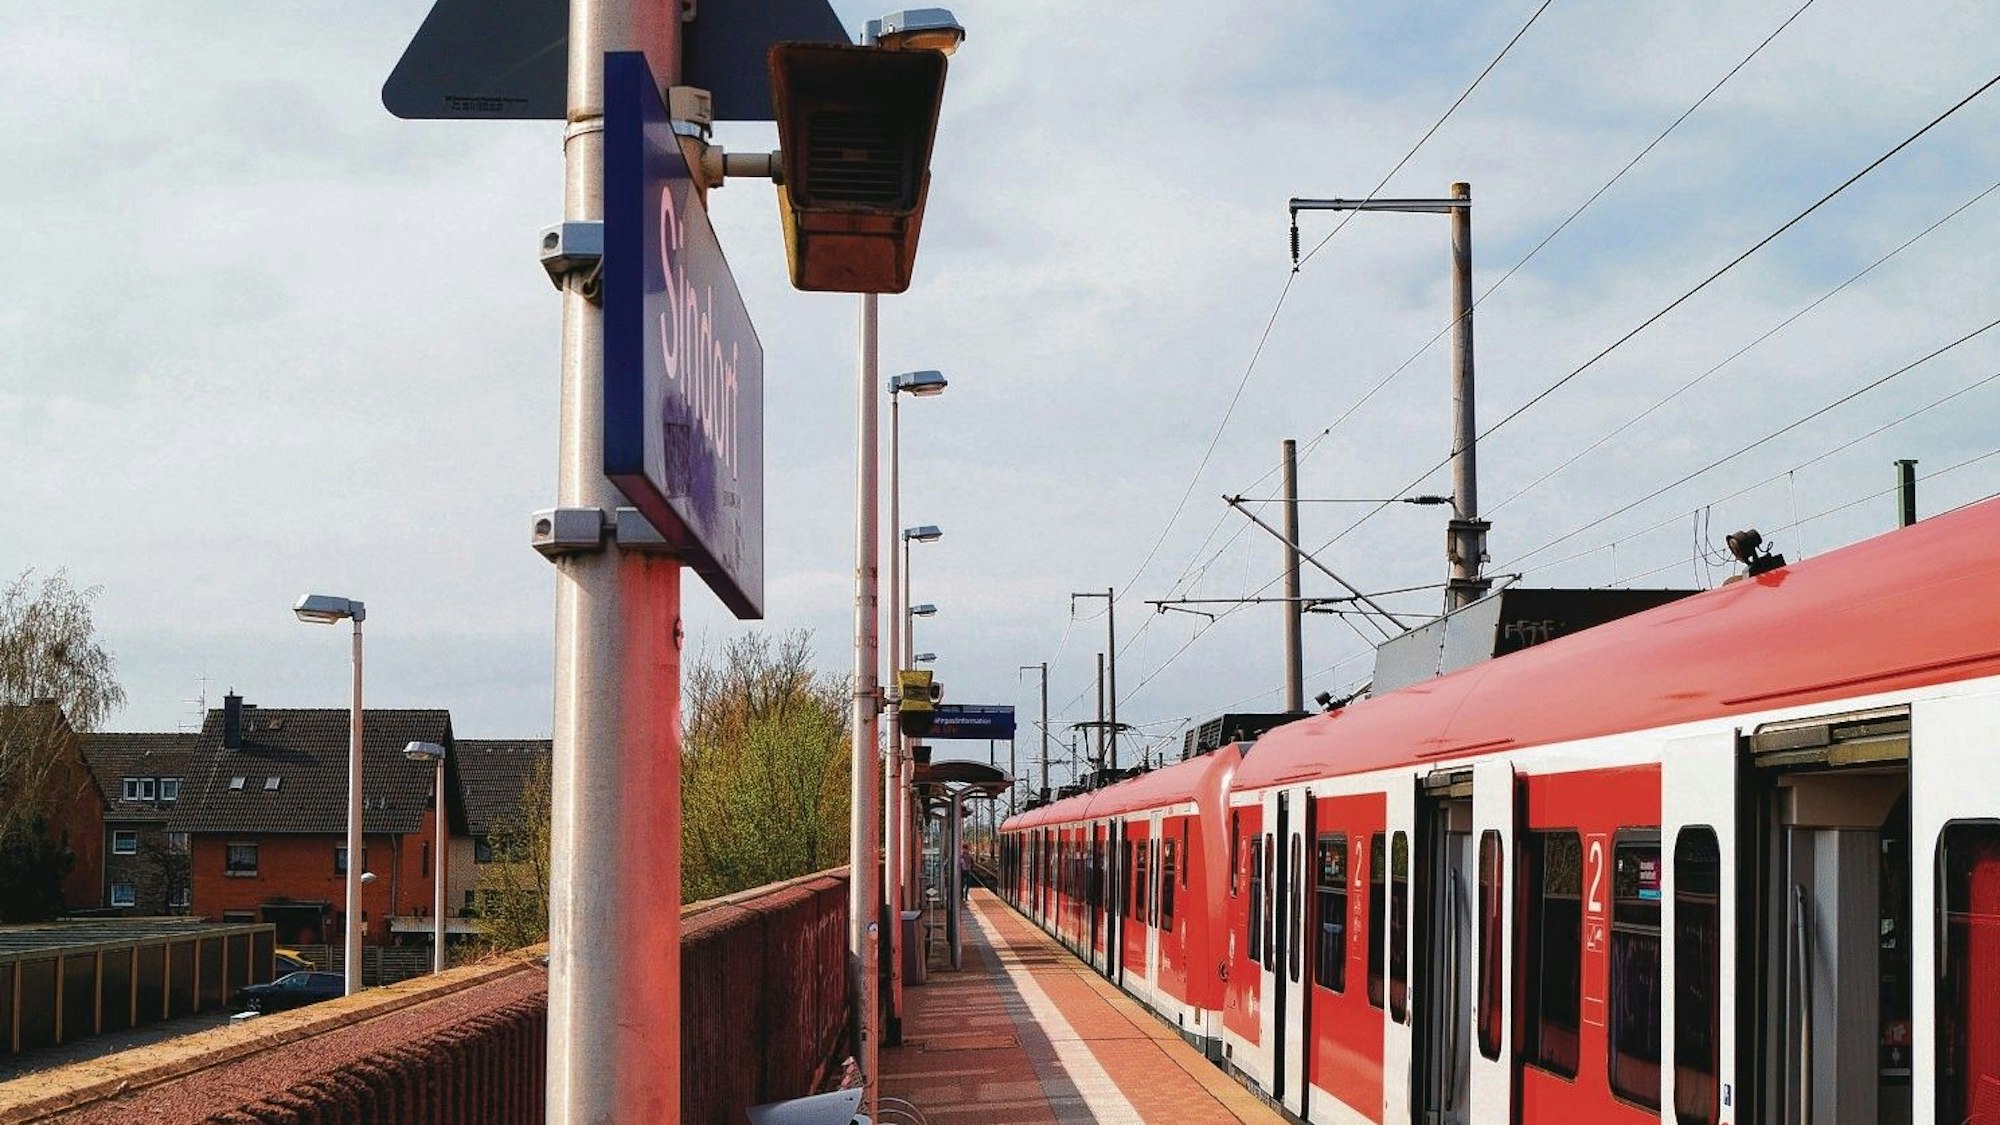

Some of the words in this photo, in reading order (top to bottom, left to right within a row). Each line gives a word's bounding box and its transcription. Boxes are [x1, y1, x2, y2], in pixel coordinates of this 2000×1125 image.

[661, 186, 738, 482] Sindorf
[1354, 840, 1363, 887] 2
[1588, 840, 1603, 912] 2
